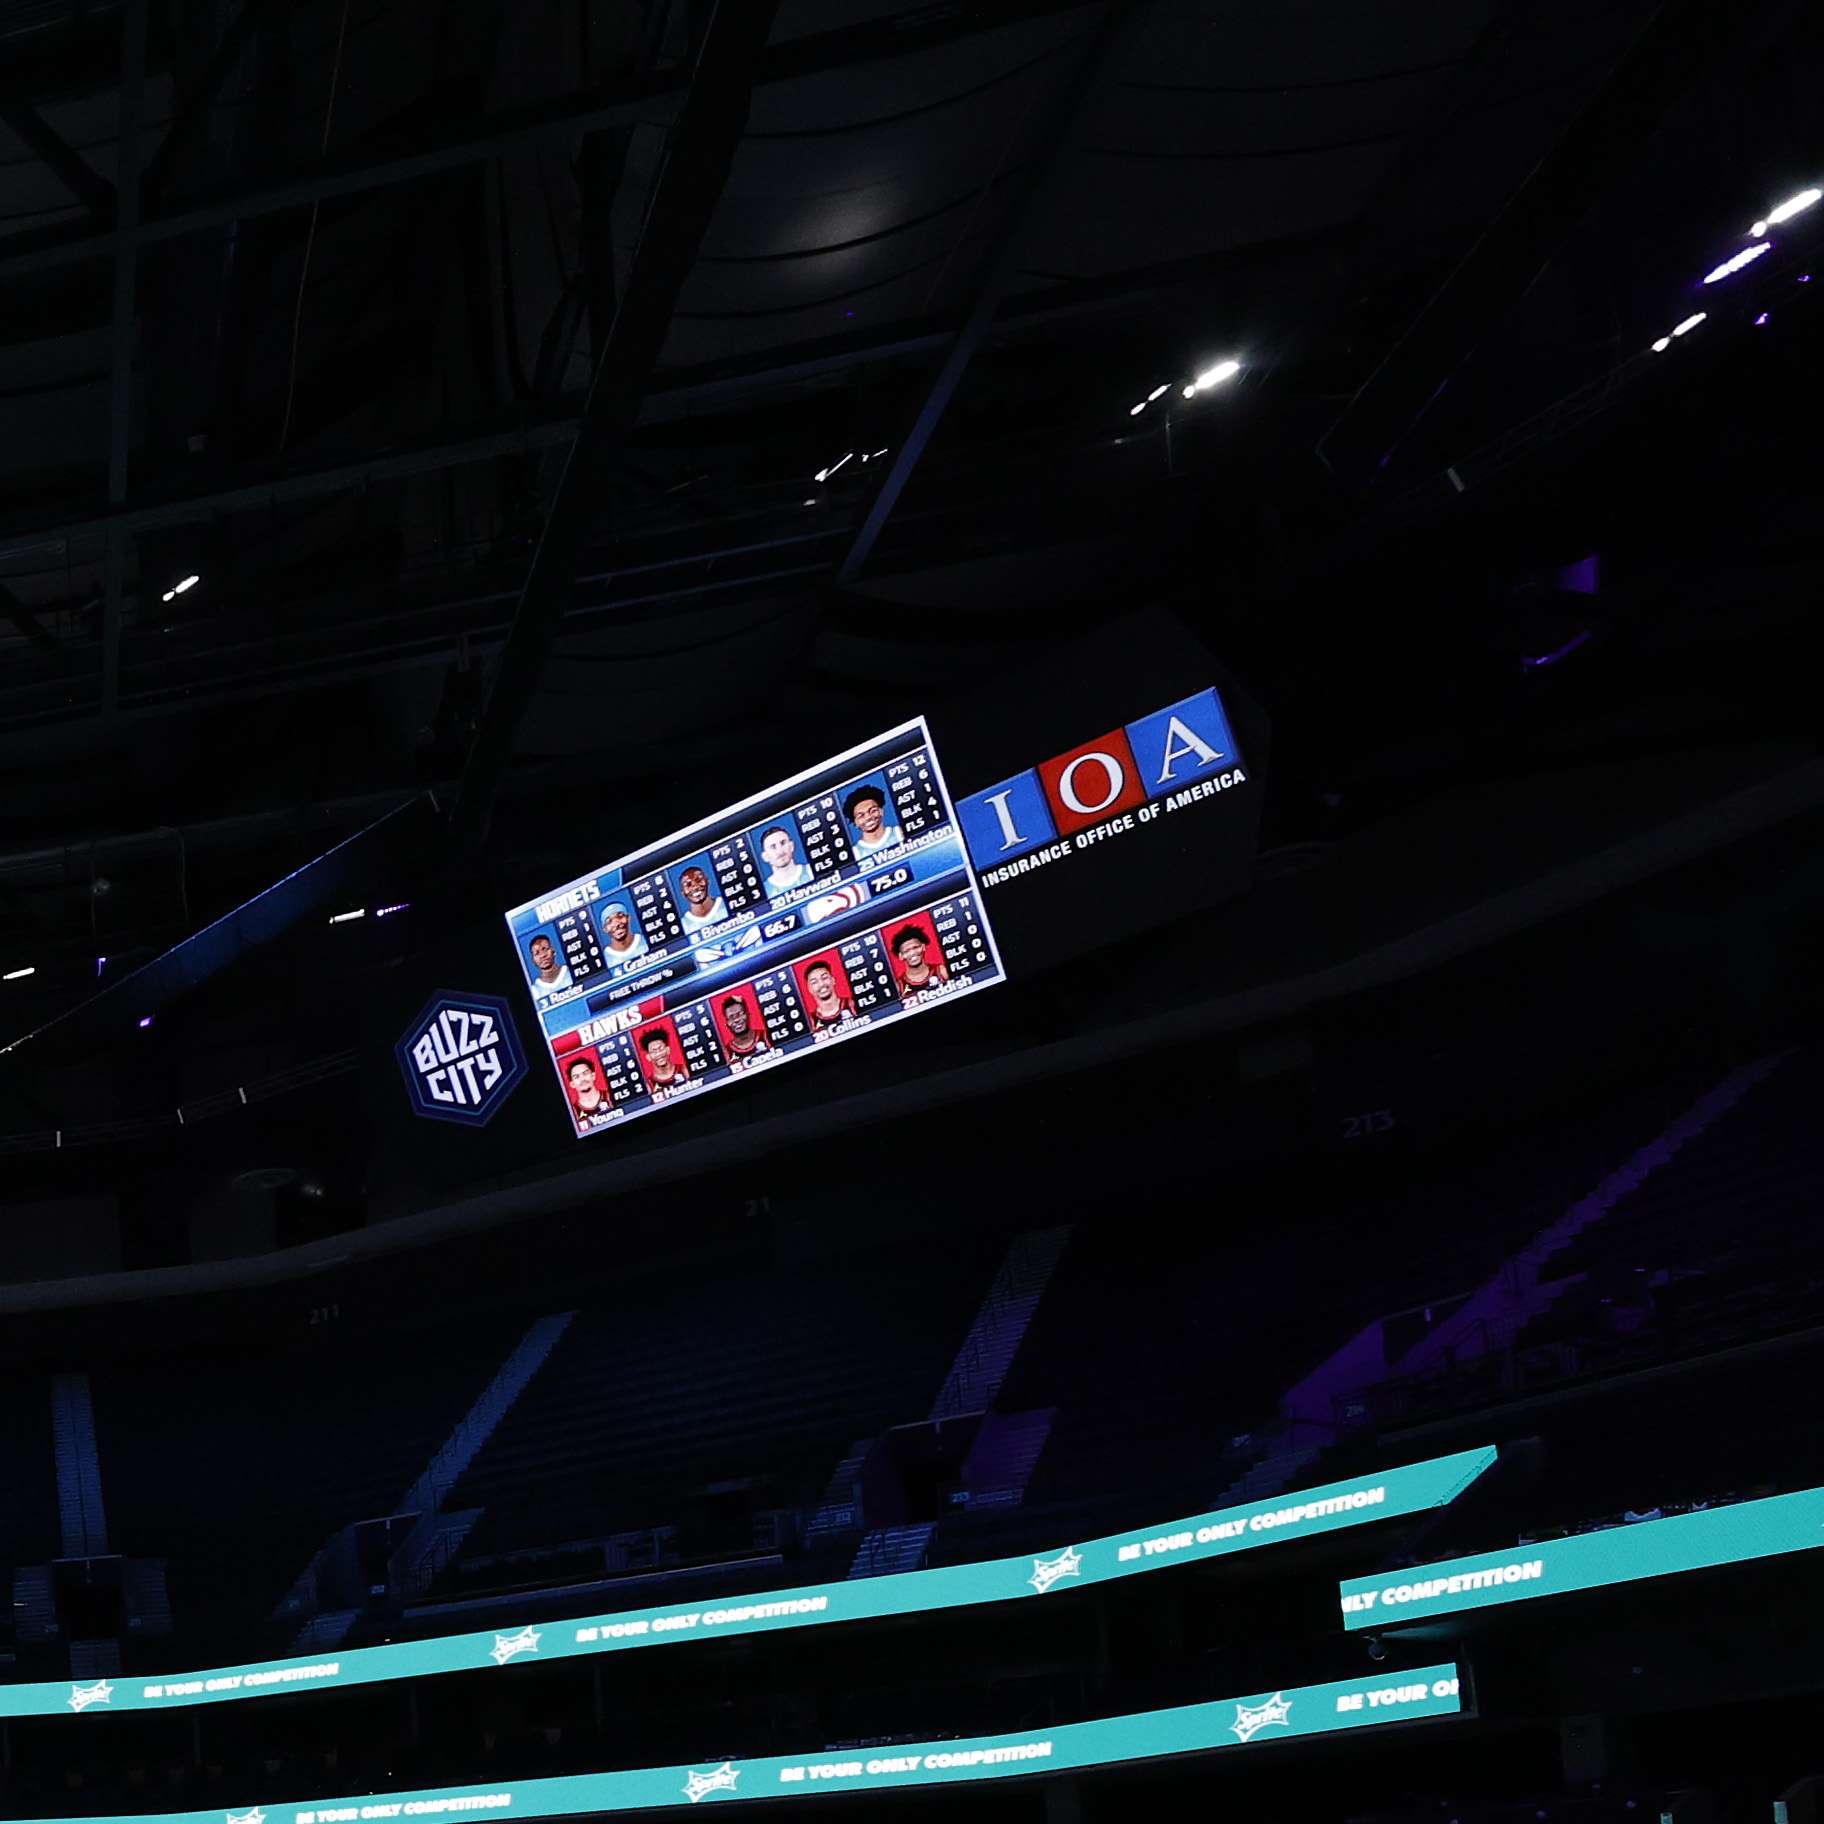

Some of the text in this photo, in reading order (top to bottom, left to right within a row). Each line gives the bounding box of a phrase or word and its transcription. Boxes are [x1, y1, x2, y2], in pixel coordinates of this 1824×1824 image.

[875, 825, 954, 867] Washington
[982, 769, 1245, 888] INSURANCE OFFICE OF AMERICA
[871, 868, 908, 893] 75.0
[535, 881, 600, 924] HORNETS
[763, 915, 797, 939] 66.7
[623, 948, 667, 973] Graham
[550, 984, 584, 1004] Rozier
[609, 983, 631, 1000] FREE
[917, 974, 972, 1005] Reddish
[413, 1010, 499, 1073] BUZZ
[579, 1004, 643, 1045] HAWKS
[828, 1013, 871, 1038] Collins
[426, 1048, 502, 1105] CITY
[663, 1076, 704, 1099] Hunter
[589, 1107, 624, 1127] Young
[1119, 1487, 1384, 1561] BE YOUR ONLY COMPETITION
[1381, 1560, 1543, 1604] COMPETITION
[780, 1743, 1052, 1782] BE YOUR ONLY COMPETITION
